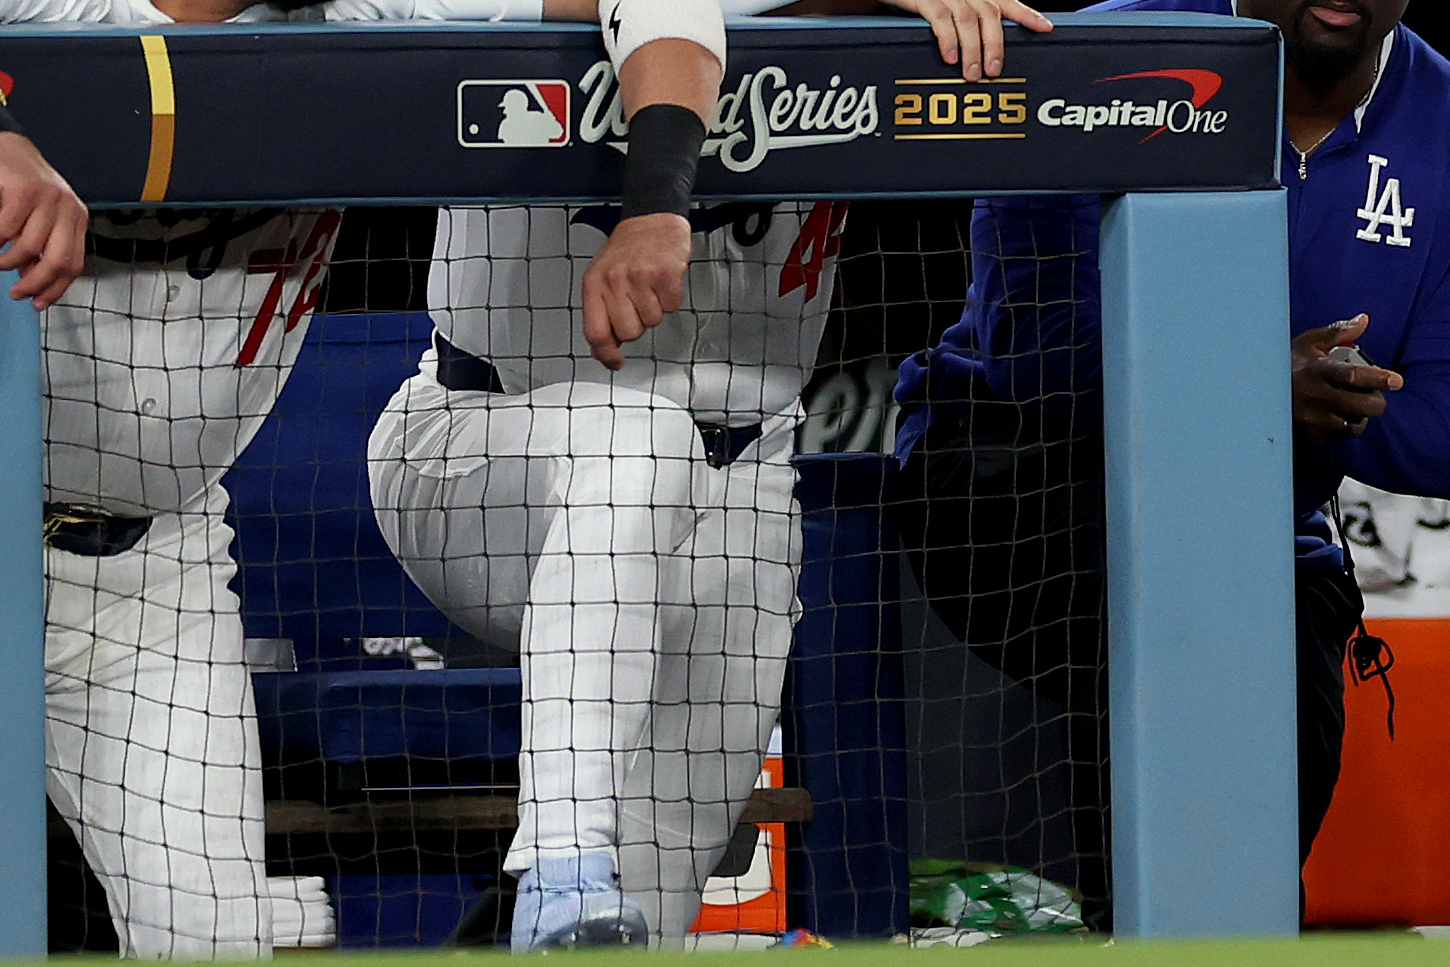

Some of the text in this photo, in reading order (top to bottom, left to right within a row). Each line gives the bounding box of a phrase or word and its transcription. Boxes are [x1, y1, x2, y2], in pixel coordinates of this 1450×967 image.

[719, 66, 1228, 172] Series 2025 Capital One
[1356, 154, 1415, 247] LA
